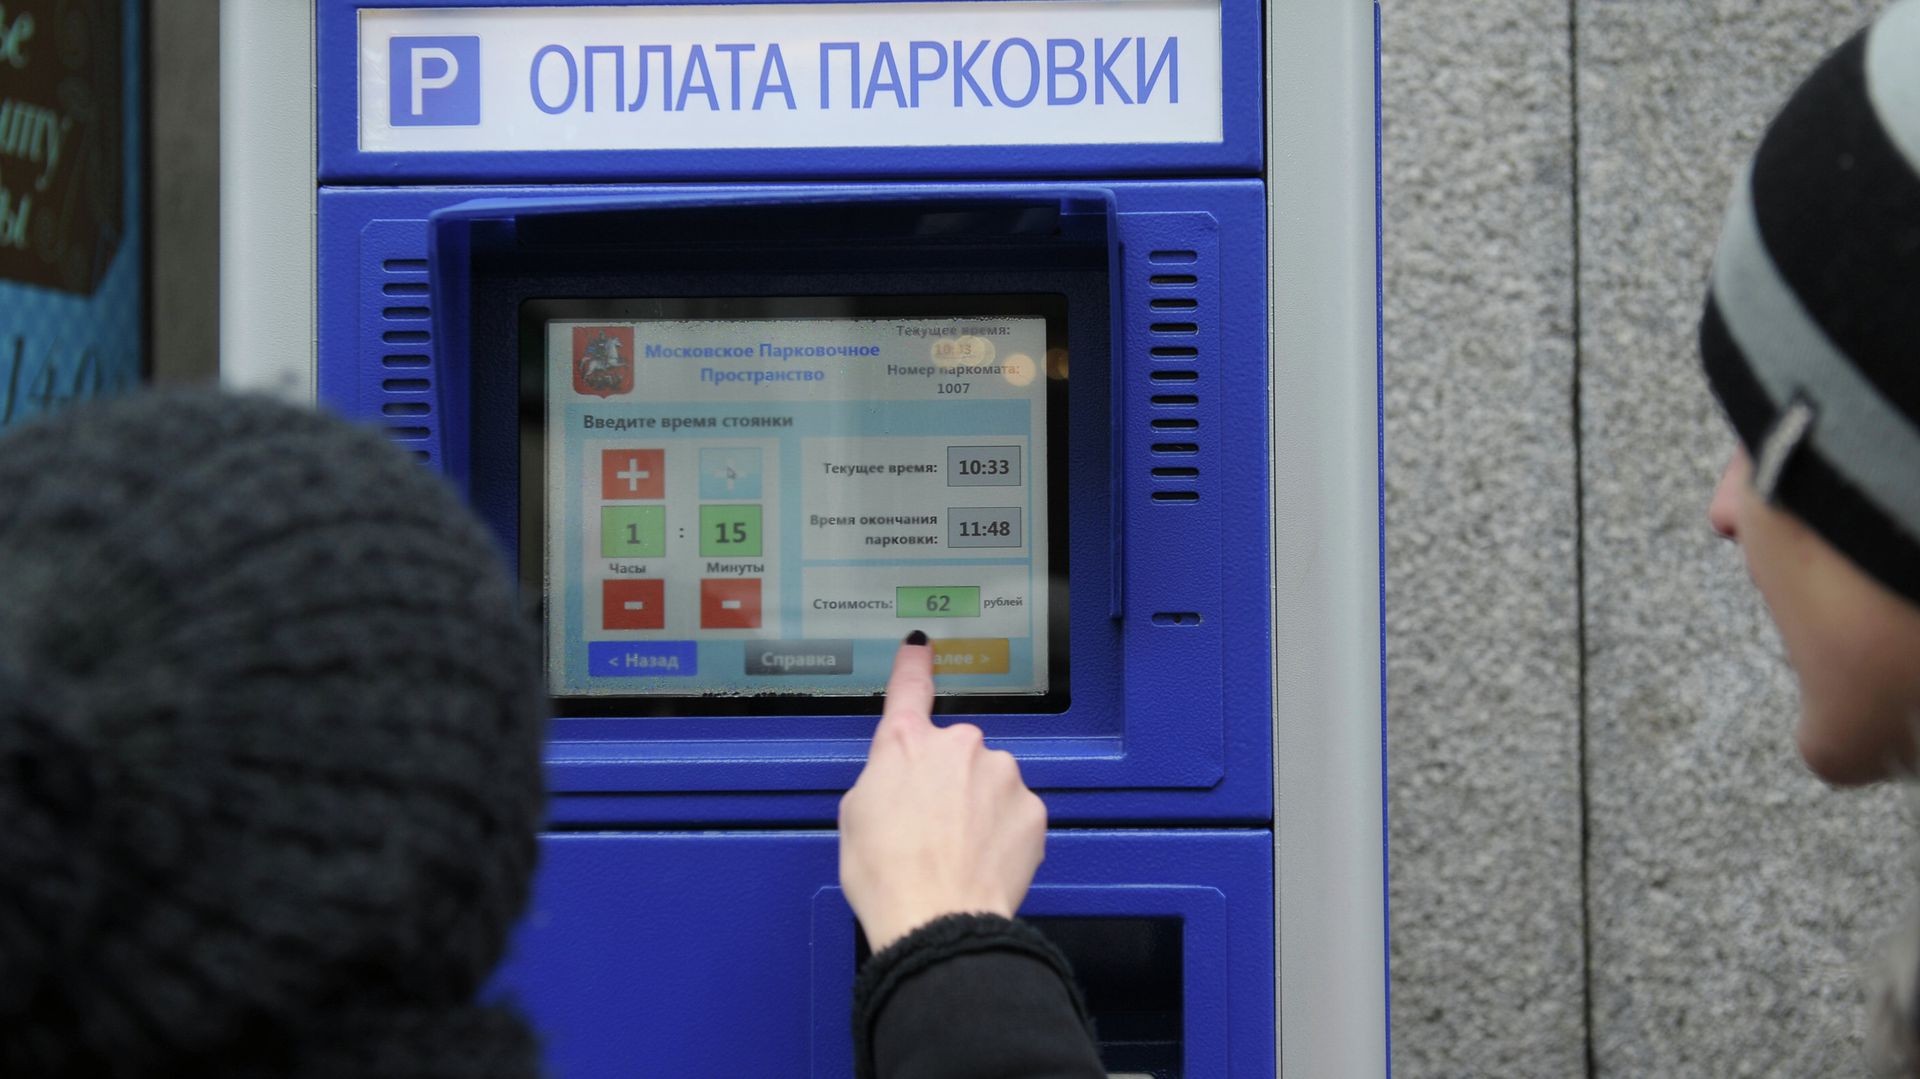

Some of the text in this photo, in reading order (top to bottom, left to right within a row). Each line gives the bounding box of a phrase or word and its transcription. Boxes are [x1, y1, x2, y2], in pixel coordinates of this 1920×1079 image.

[410, 47, 459, 116] P
[529, 37, 1180, 115] ОПЛАТА ПАРКОВКИ
[896, 325, 957, 338] Текущее
[645, 343, 880, 360] Московское Парковочное
[701, 368, 824, 385] Пространство
[887, 364, 1020, 377] Номер паркомата:
[937, 382, 970, 394] 1007
[583, 415, 793, 431] Введите время стоянки
[824, 462, 937, 477] Текущее время:
[959, 460, 1010, 475] 10:33
[810, 514, 937, 528] Время окончания
[627, 524, 640, 544] 1
[715, 522, 746, 543] 15
[959, 522, 1010, 537] 11:48
[865, 535, 938, 548] парковки:
[610, 563, 646, 576] Часы
[707, 562, 764, 576] Минуты
[813, 595, 1022, 612] Стоимость: 62 рублей
[625, 653, 679, 670] Назад
[762, 653, 836, 669] Справка
[933, 653, 973, 665] алее
